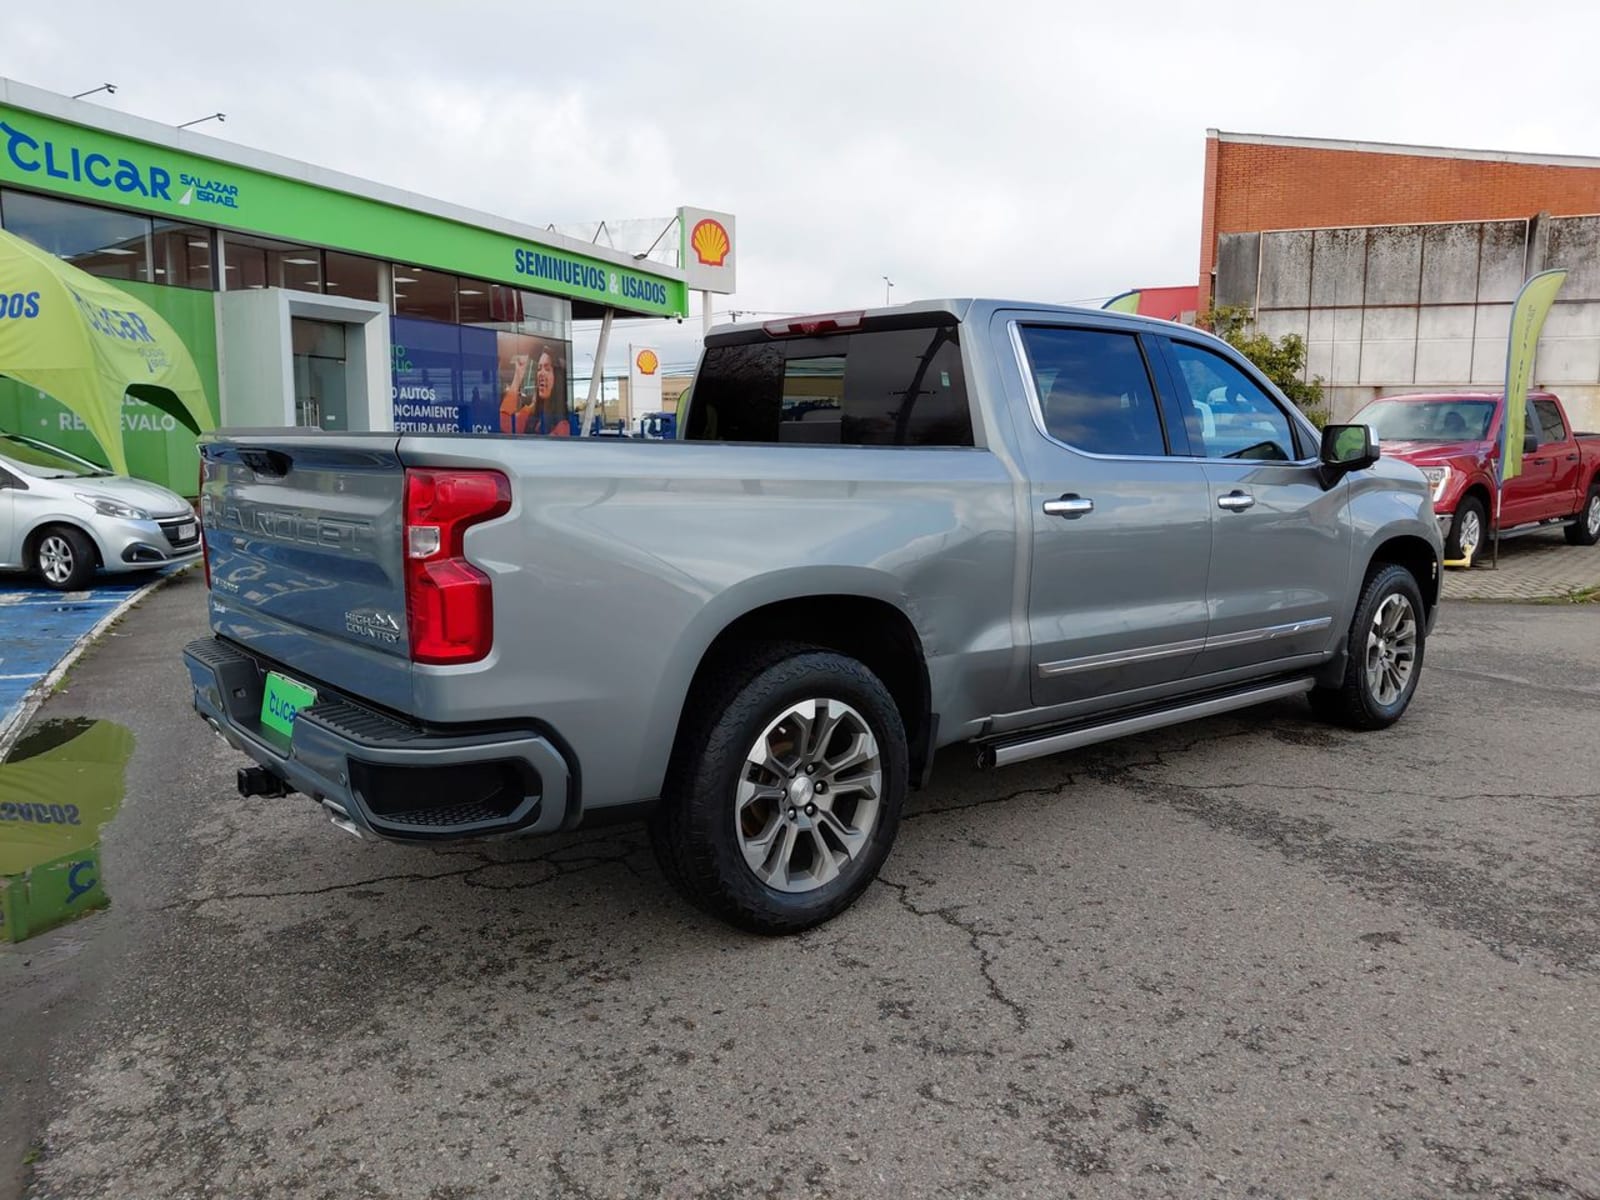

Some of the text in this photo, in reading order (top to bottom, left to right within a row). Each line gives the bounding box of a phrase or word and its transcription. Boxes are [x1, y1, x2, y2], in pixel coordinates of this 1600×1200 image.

[180, 173, 238, 197] SALAZAR
[196, 189, 239, 209] ISRAEL
[514, 248, 667, 305] SEMINUEVOS & USADOS
[400, 387, 436, 401] AUTOS
[344, 611, 371, 628] HIGH
[346, 623, 401, 645] COUNTRY
